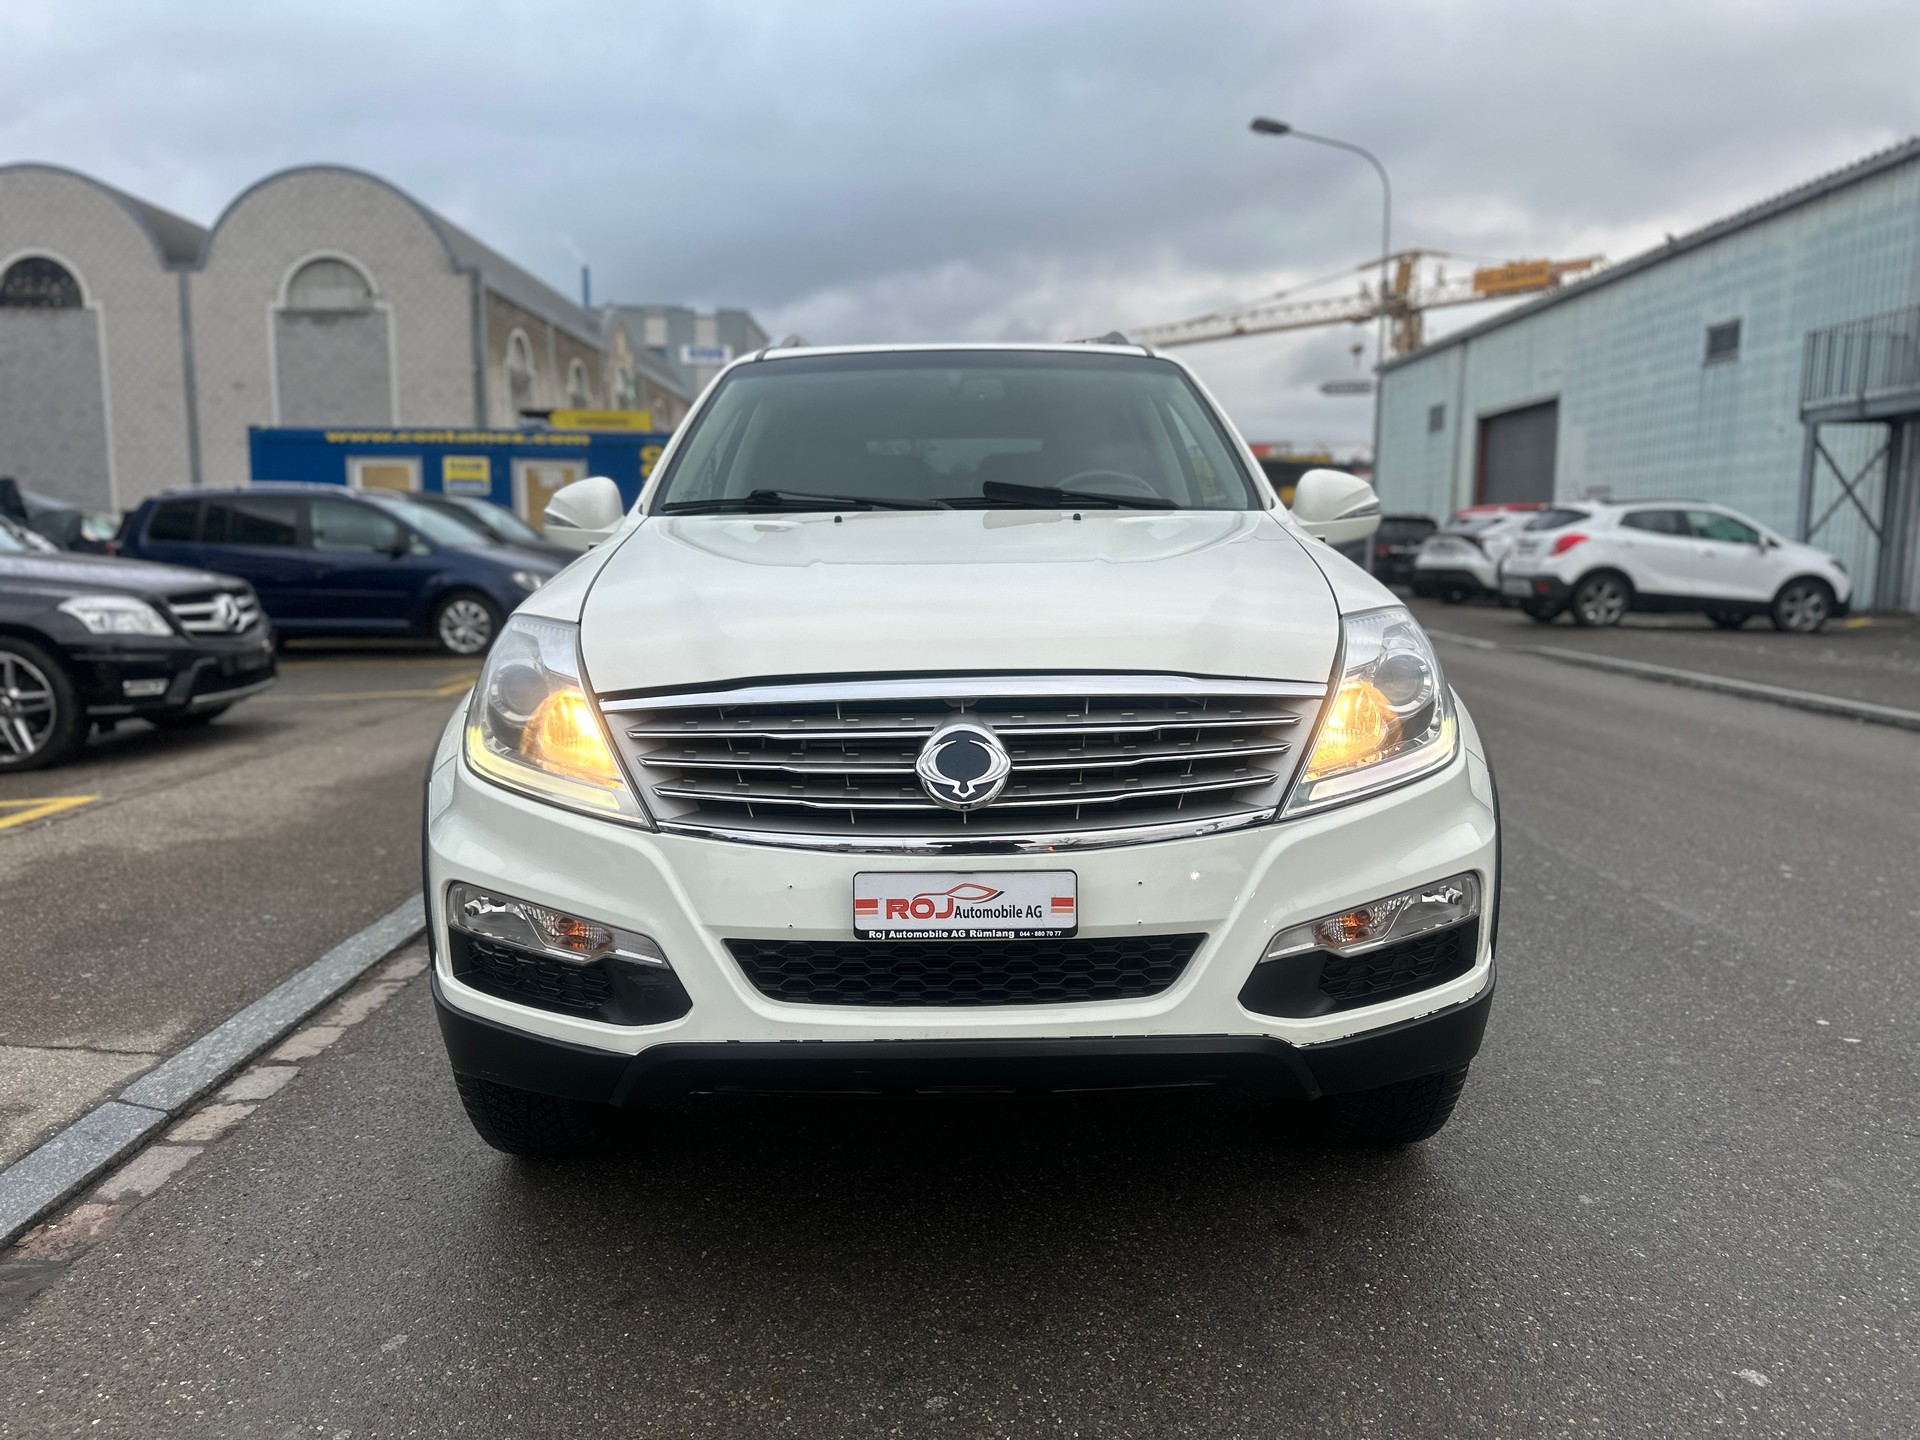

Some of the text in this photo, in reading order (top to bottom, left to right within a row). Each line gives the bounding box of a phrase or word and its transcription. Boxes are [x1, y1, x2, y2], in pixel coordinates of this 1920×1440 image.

[886, 898, 1042, 919] ROJ Automobile AG
[868, 931, 885, 940] Roj
[889, 930, 948, 938] Automobile
[950, 930, 966, 938] AG
[969, 929, 1015, 939] Rümlang
